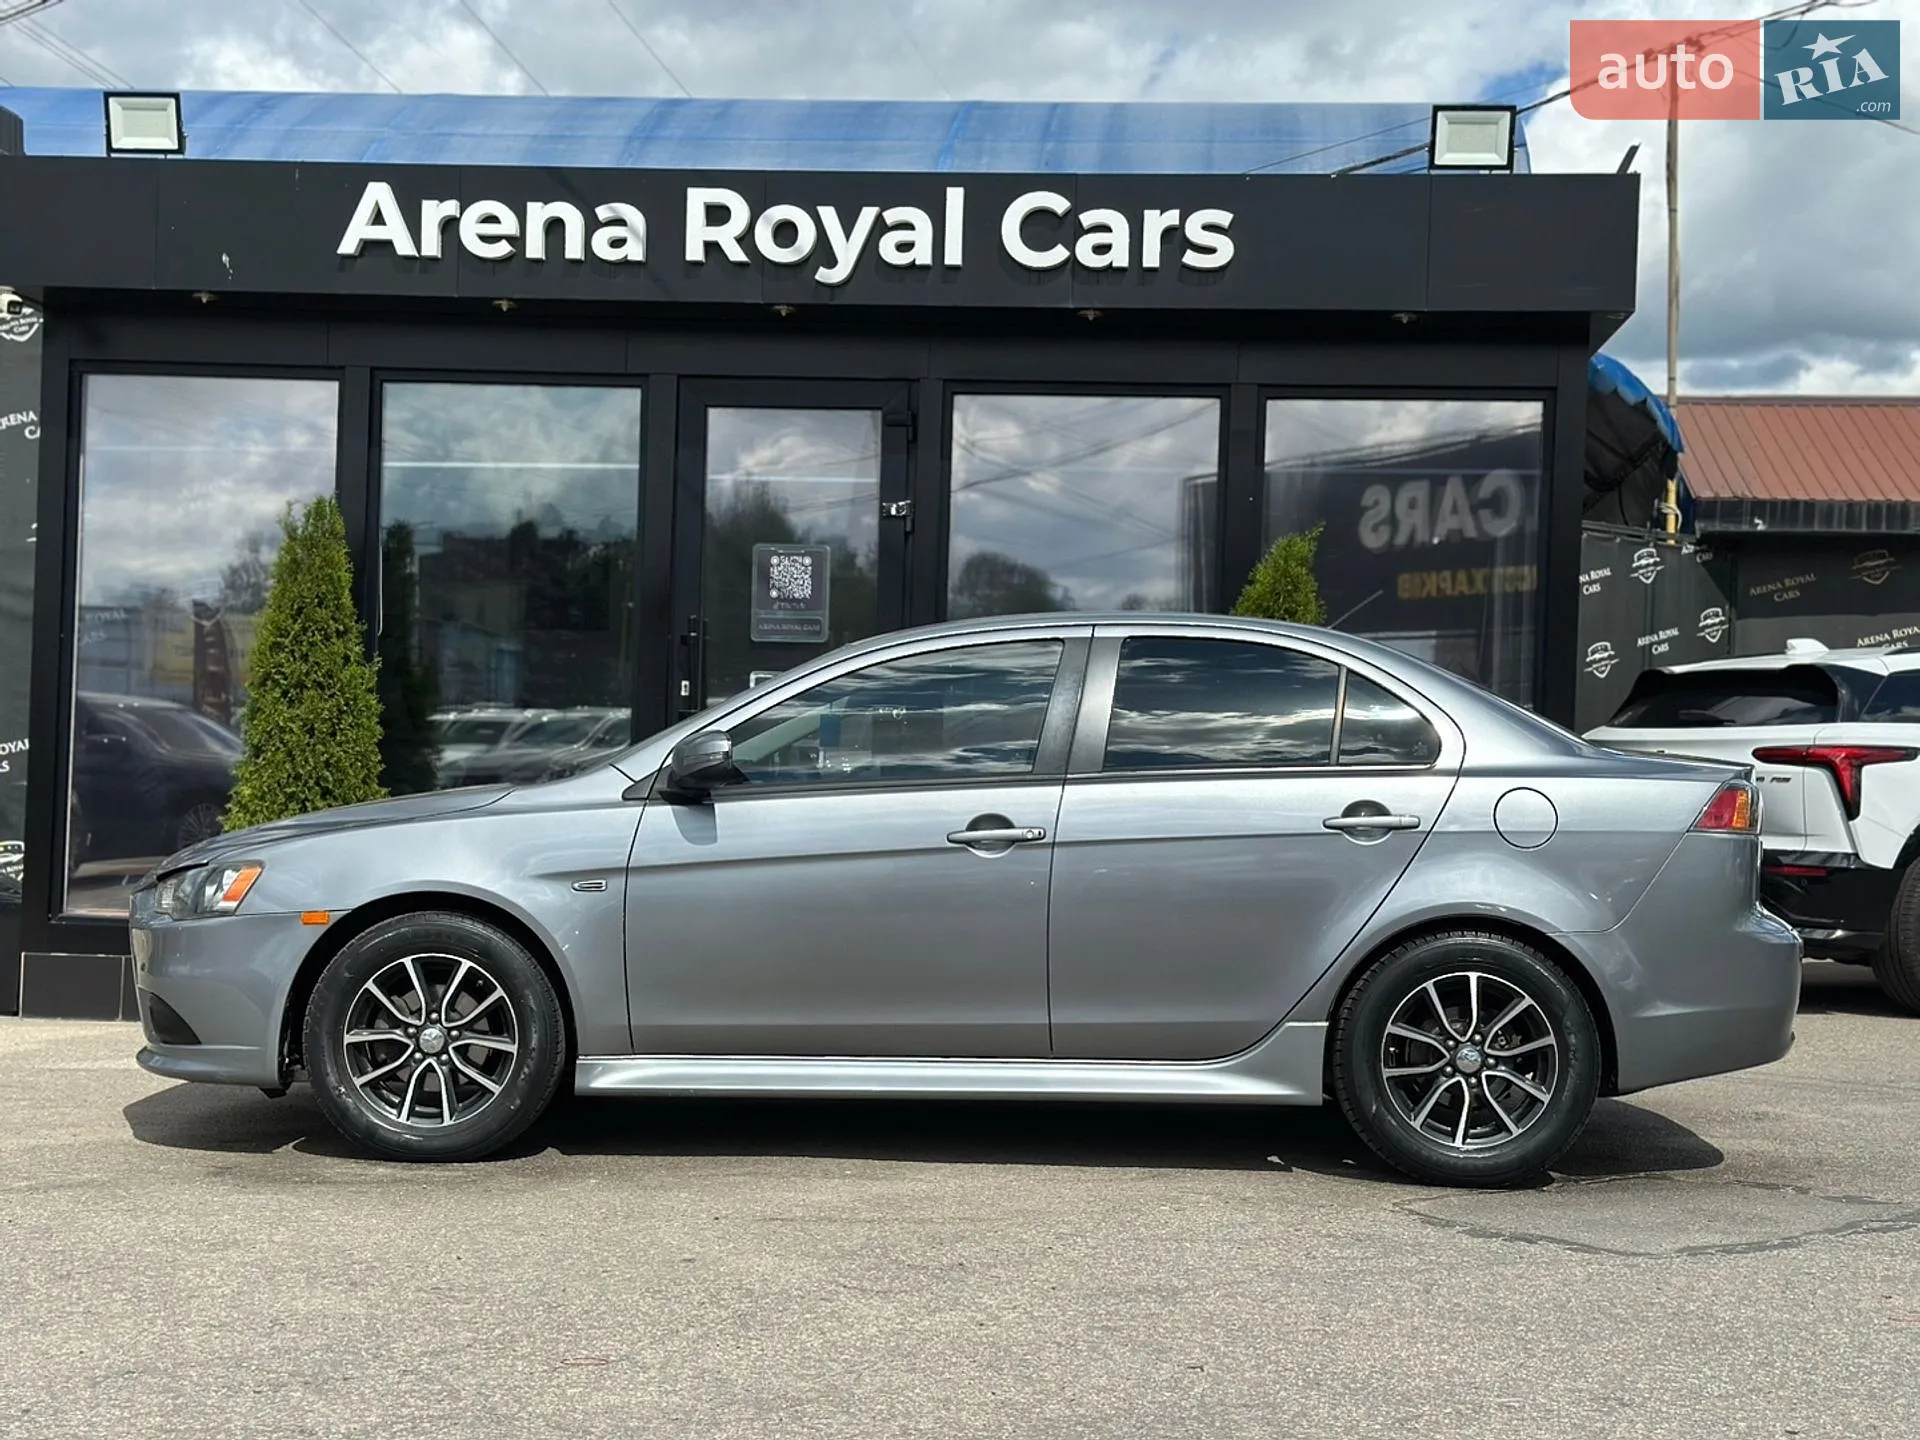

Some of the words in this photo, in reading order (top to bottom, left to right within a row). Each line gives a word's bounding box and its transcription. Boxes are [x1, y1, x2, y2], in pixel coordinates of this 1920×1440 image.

[336, 181, 648, 263] Arena
[685, 186, 965, 286] Royal
[1001, 190, 1235, 271] Cars
[1749, 581, 1784, 597] ARENA
[1783, 572, 1817, 589] ROYAL
[1773, 589, 1801, 602] CARS
[1856, 632, 1891, 648] ARENA
